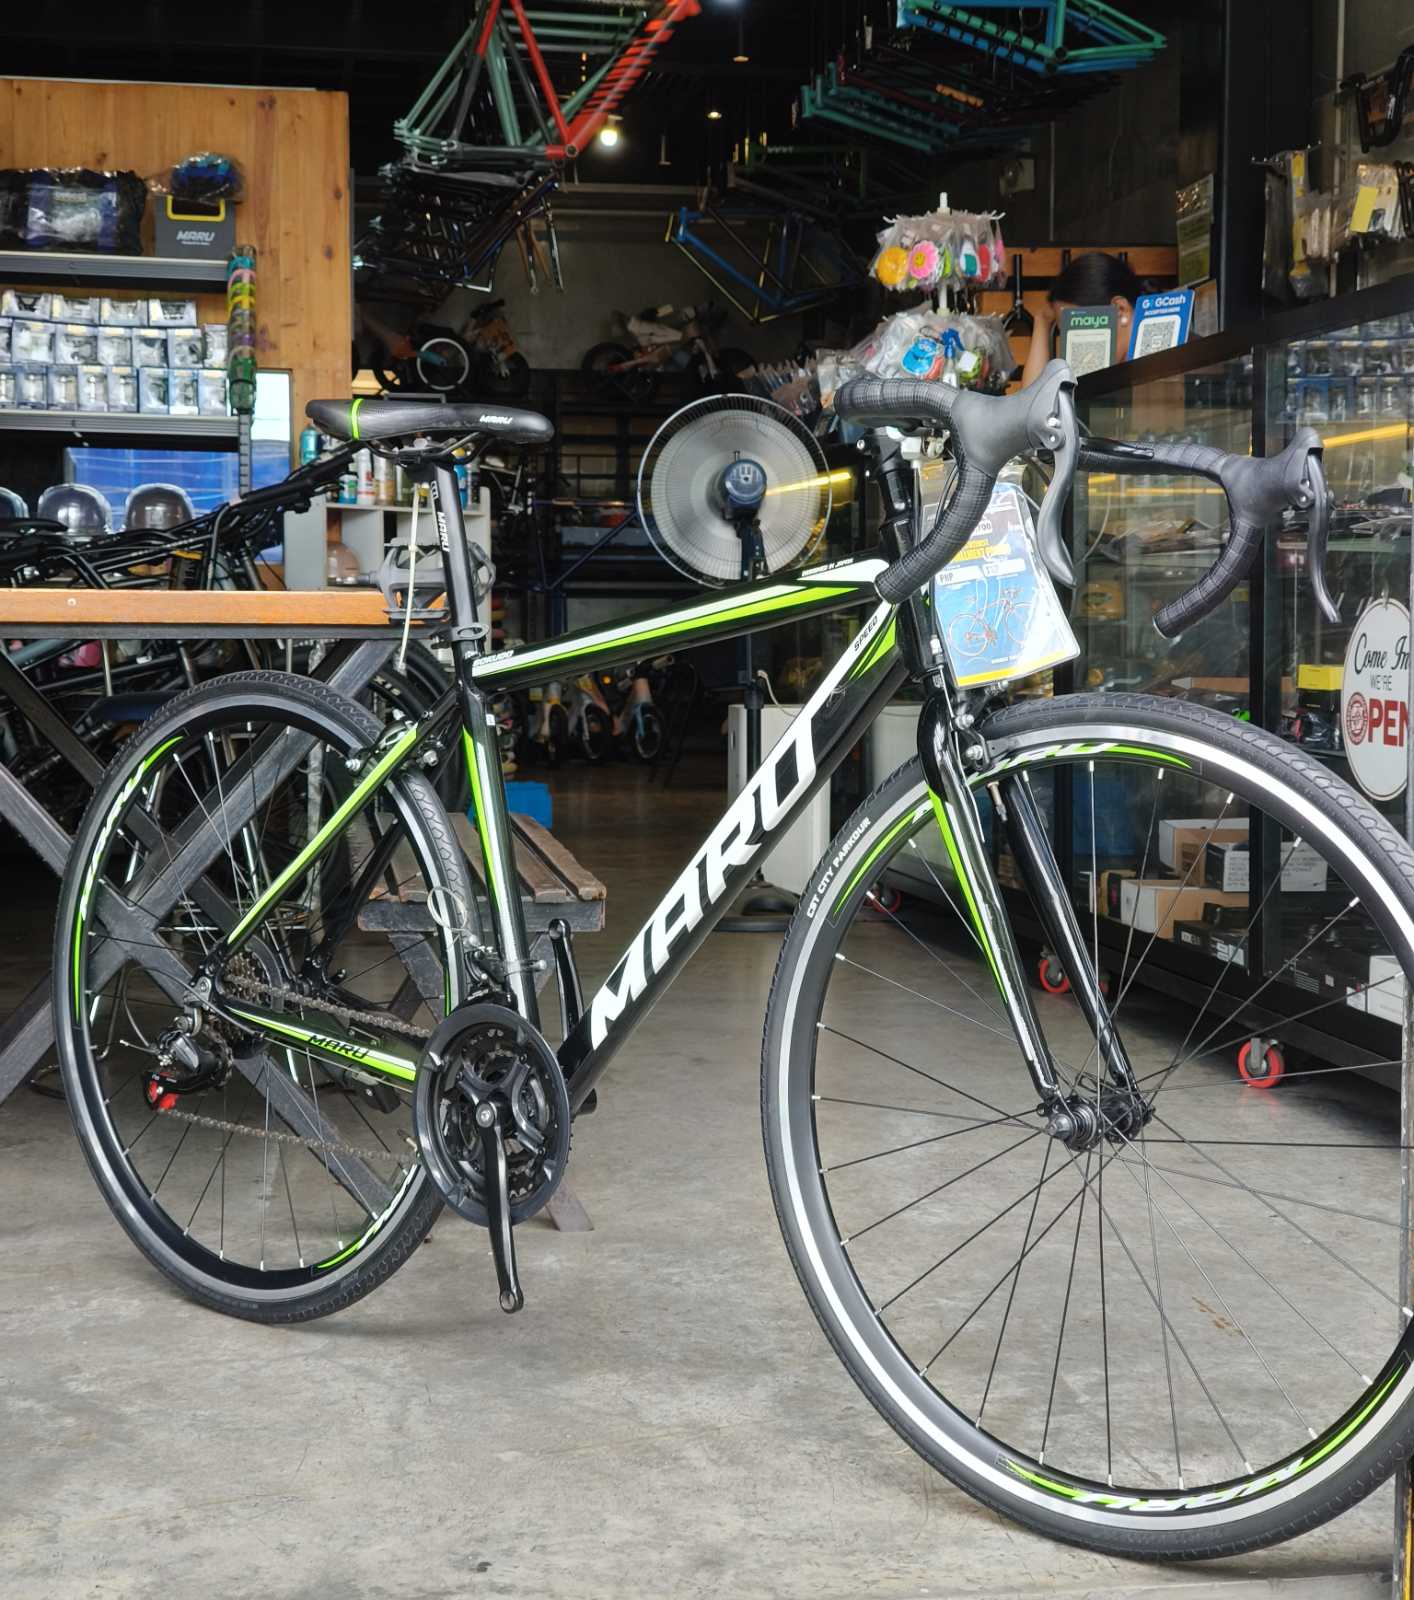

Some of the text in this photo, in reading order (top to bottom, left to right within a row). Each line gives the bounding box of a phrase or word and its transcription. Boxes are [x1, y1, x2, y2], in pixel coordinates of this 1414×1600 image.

[176, 230, 215, 242] MARU
[1155, 294, 1186, 307] GCash
[1070, 314, 1109, 328] maya
[479, 414, 513, 424] MARU
[437, 511, 451, 552] MARU
[854, 615, 878, 652] SPEED
[1354, 632, 1388, 675] Come
[807, 816, 872, 919] CST CITY PARKOUR
[590, 716, 818, 1051] MARU
[308, 1034, 369, 1060] MARU
